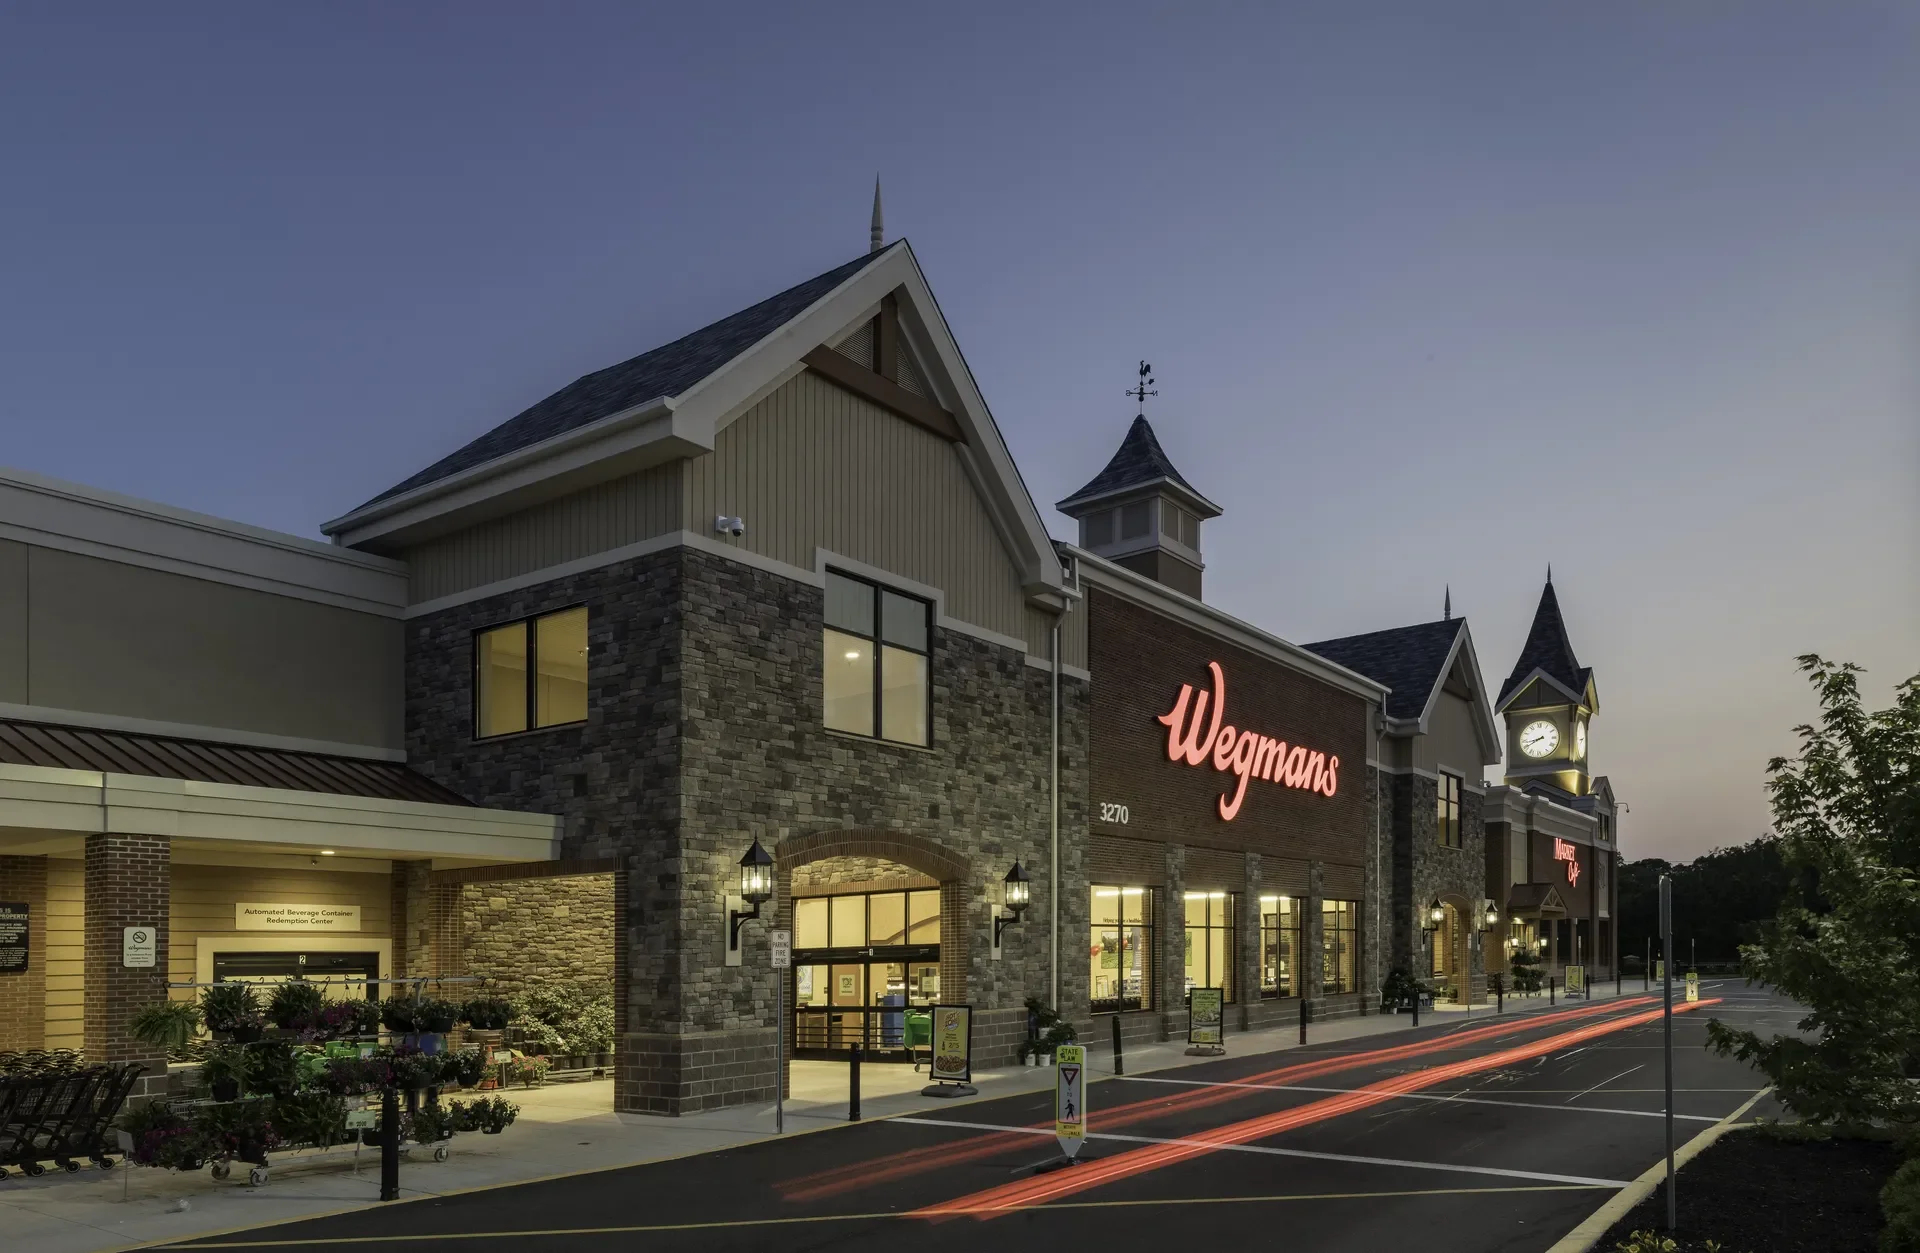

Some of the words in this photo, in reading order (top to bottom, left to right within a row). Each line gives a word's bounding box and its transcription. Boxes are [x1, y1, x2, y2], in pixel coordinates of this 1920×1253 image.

[1156, 661, 1339, 821] Wegmans
[1100, 802, 1129, 824] 3270
[287, 909, 320, 917] Beverage
[266, 917, 309, 925] Redemption
[774, 957, 787, 965] ZONE
